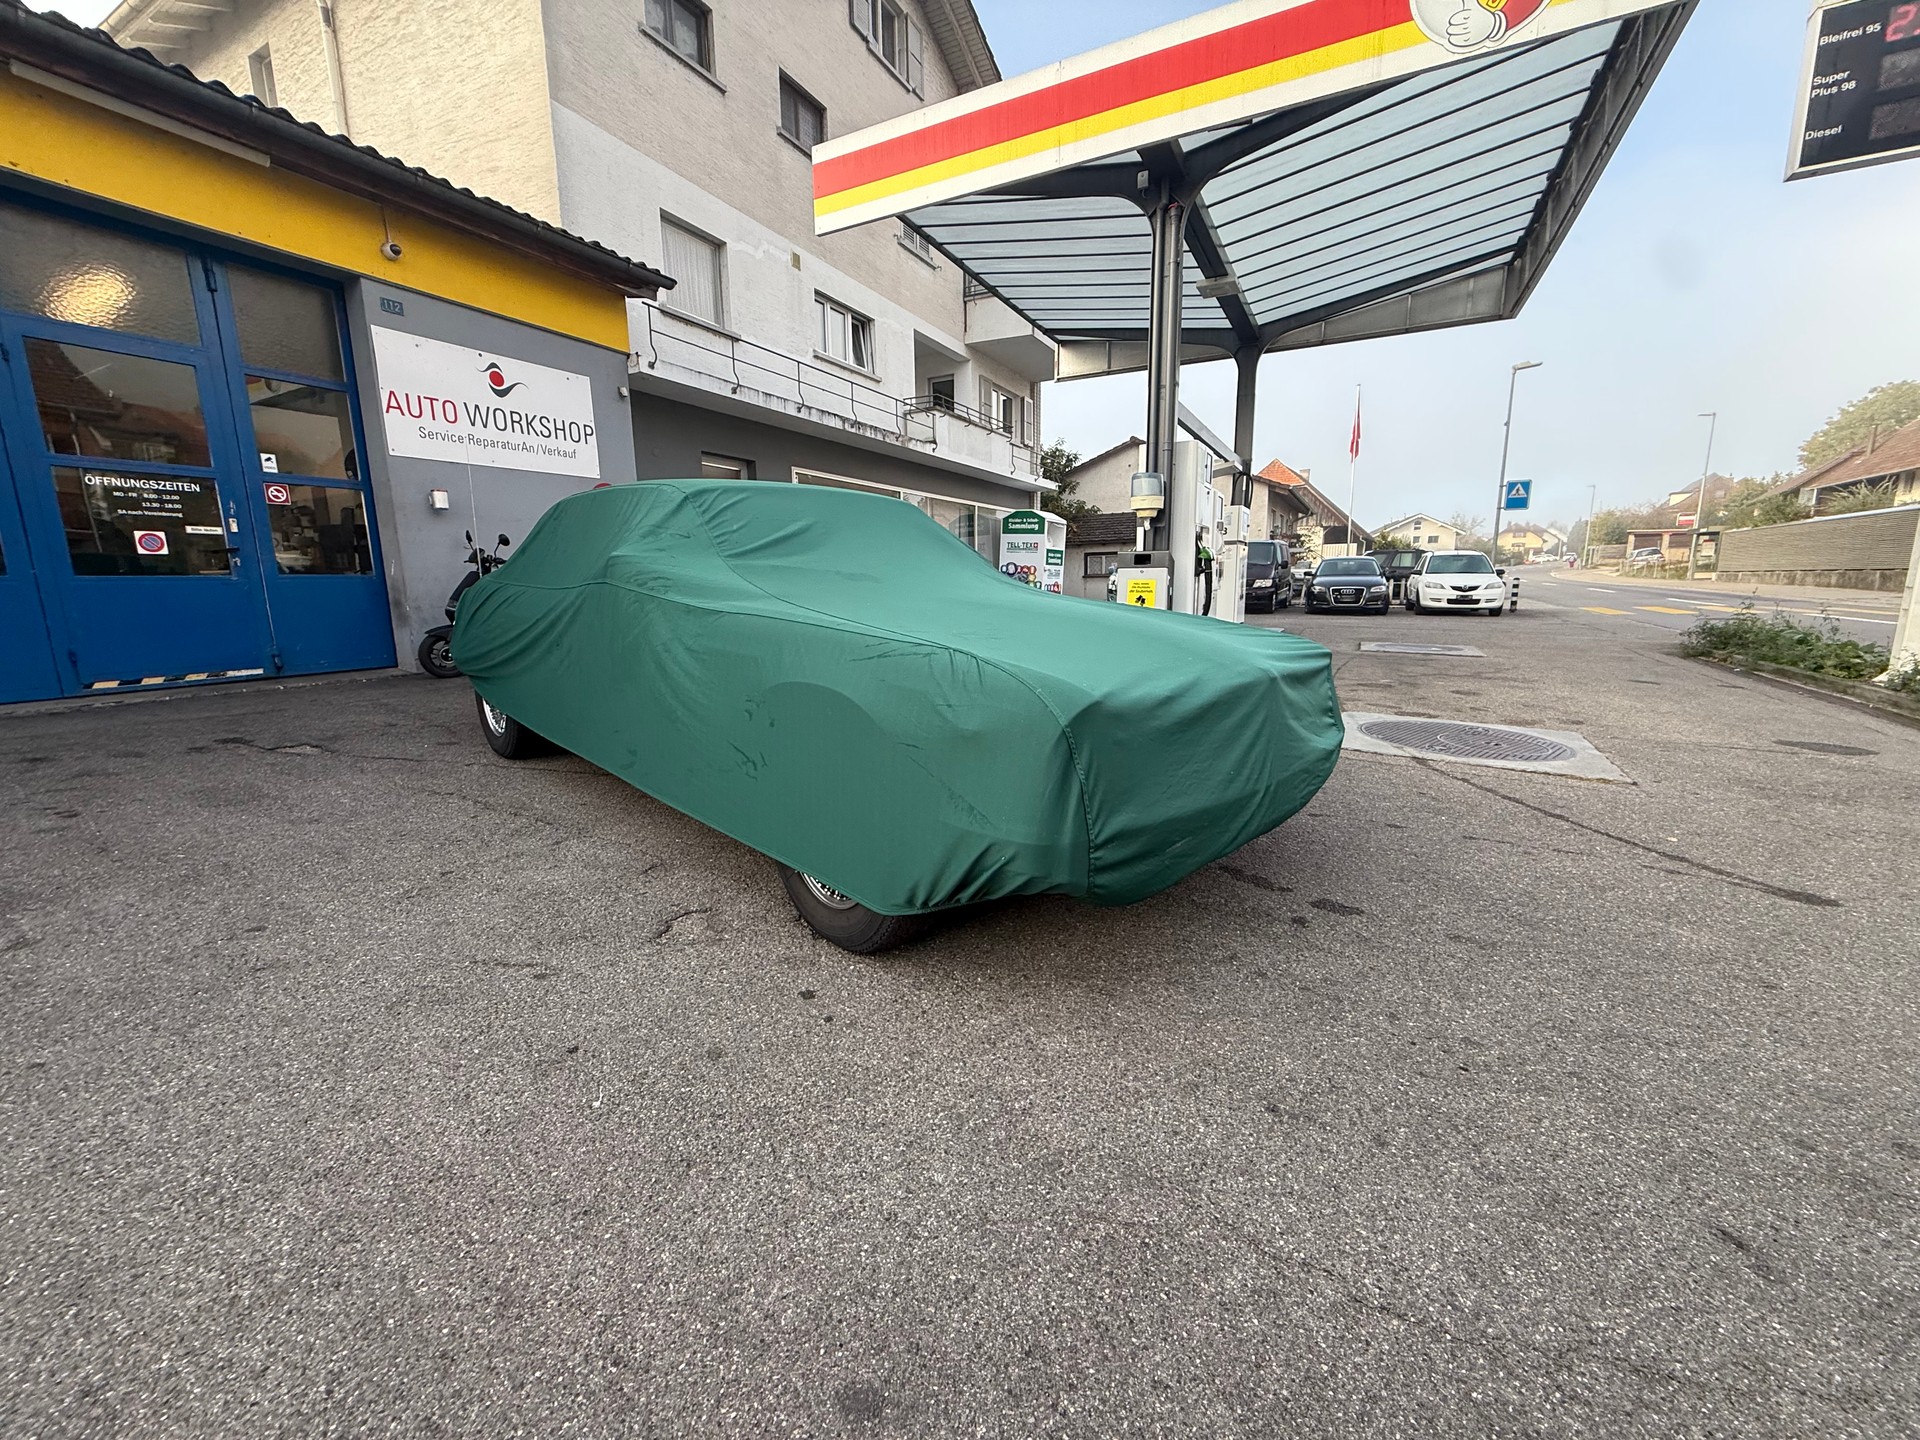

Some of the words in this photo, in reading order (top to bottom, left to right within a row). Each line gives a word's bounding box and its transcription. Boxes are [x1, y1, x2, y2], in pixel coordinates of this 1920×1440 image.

[1820, 27, 1863, 46] Bleifrei
[1865, 22, 1882, 34] 95
[1812, 70, 1850, 86] Super
[1811, 86, 1838, 98] Plus
[1841, 80, 1857, 91] 98
[1804, 124, 1843, 140] Diesel
[383, 299, 401, 313] 112
[385, 390, 458, 424] AUTO
[463, 401, 594, 445] WORKSHOP
[418, 426, 464, 444] Service
[85, 474, 200, 492] ÖFFNUNGSZEITEN
